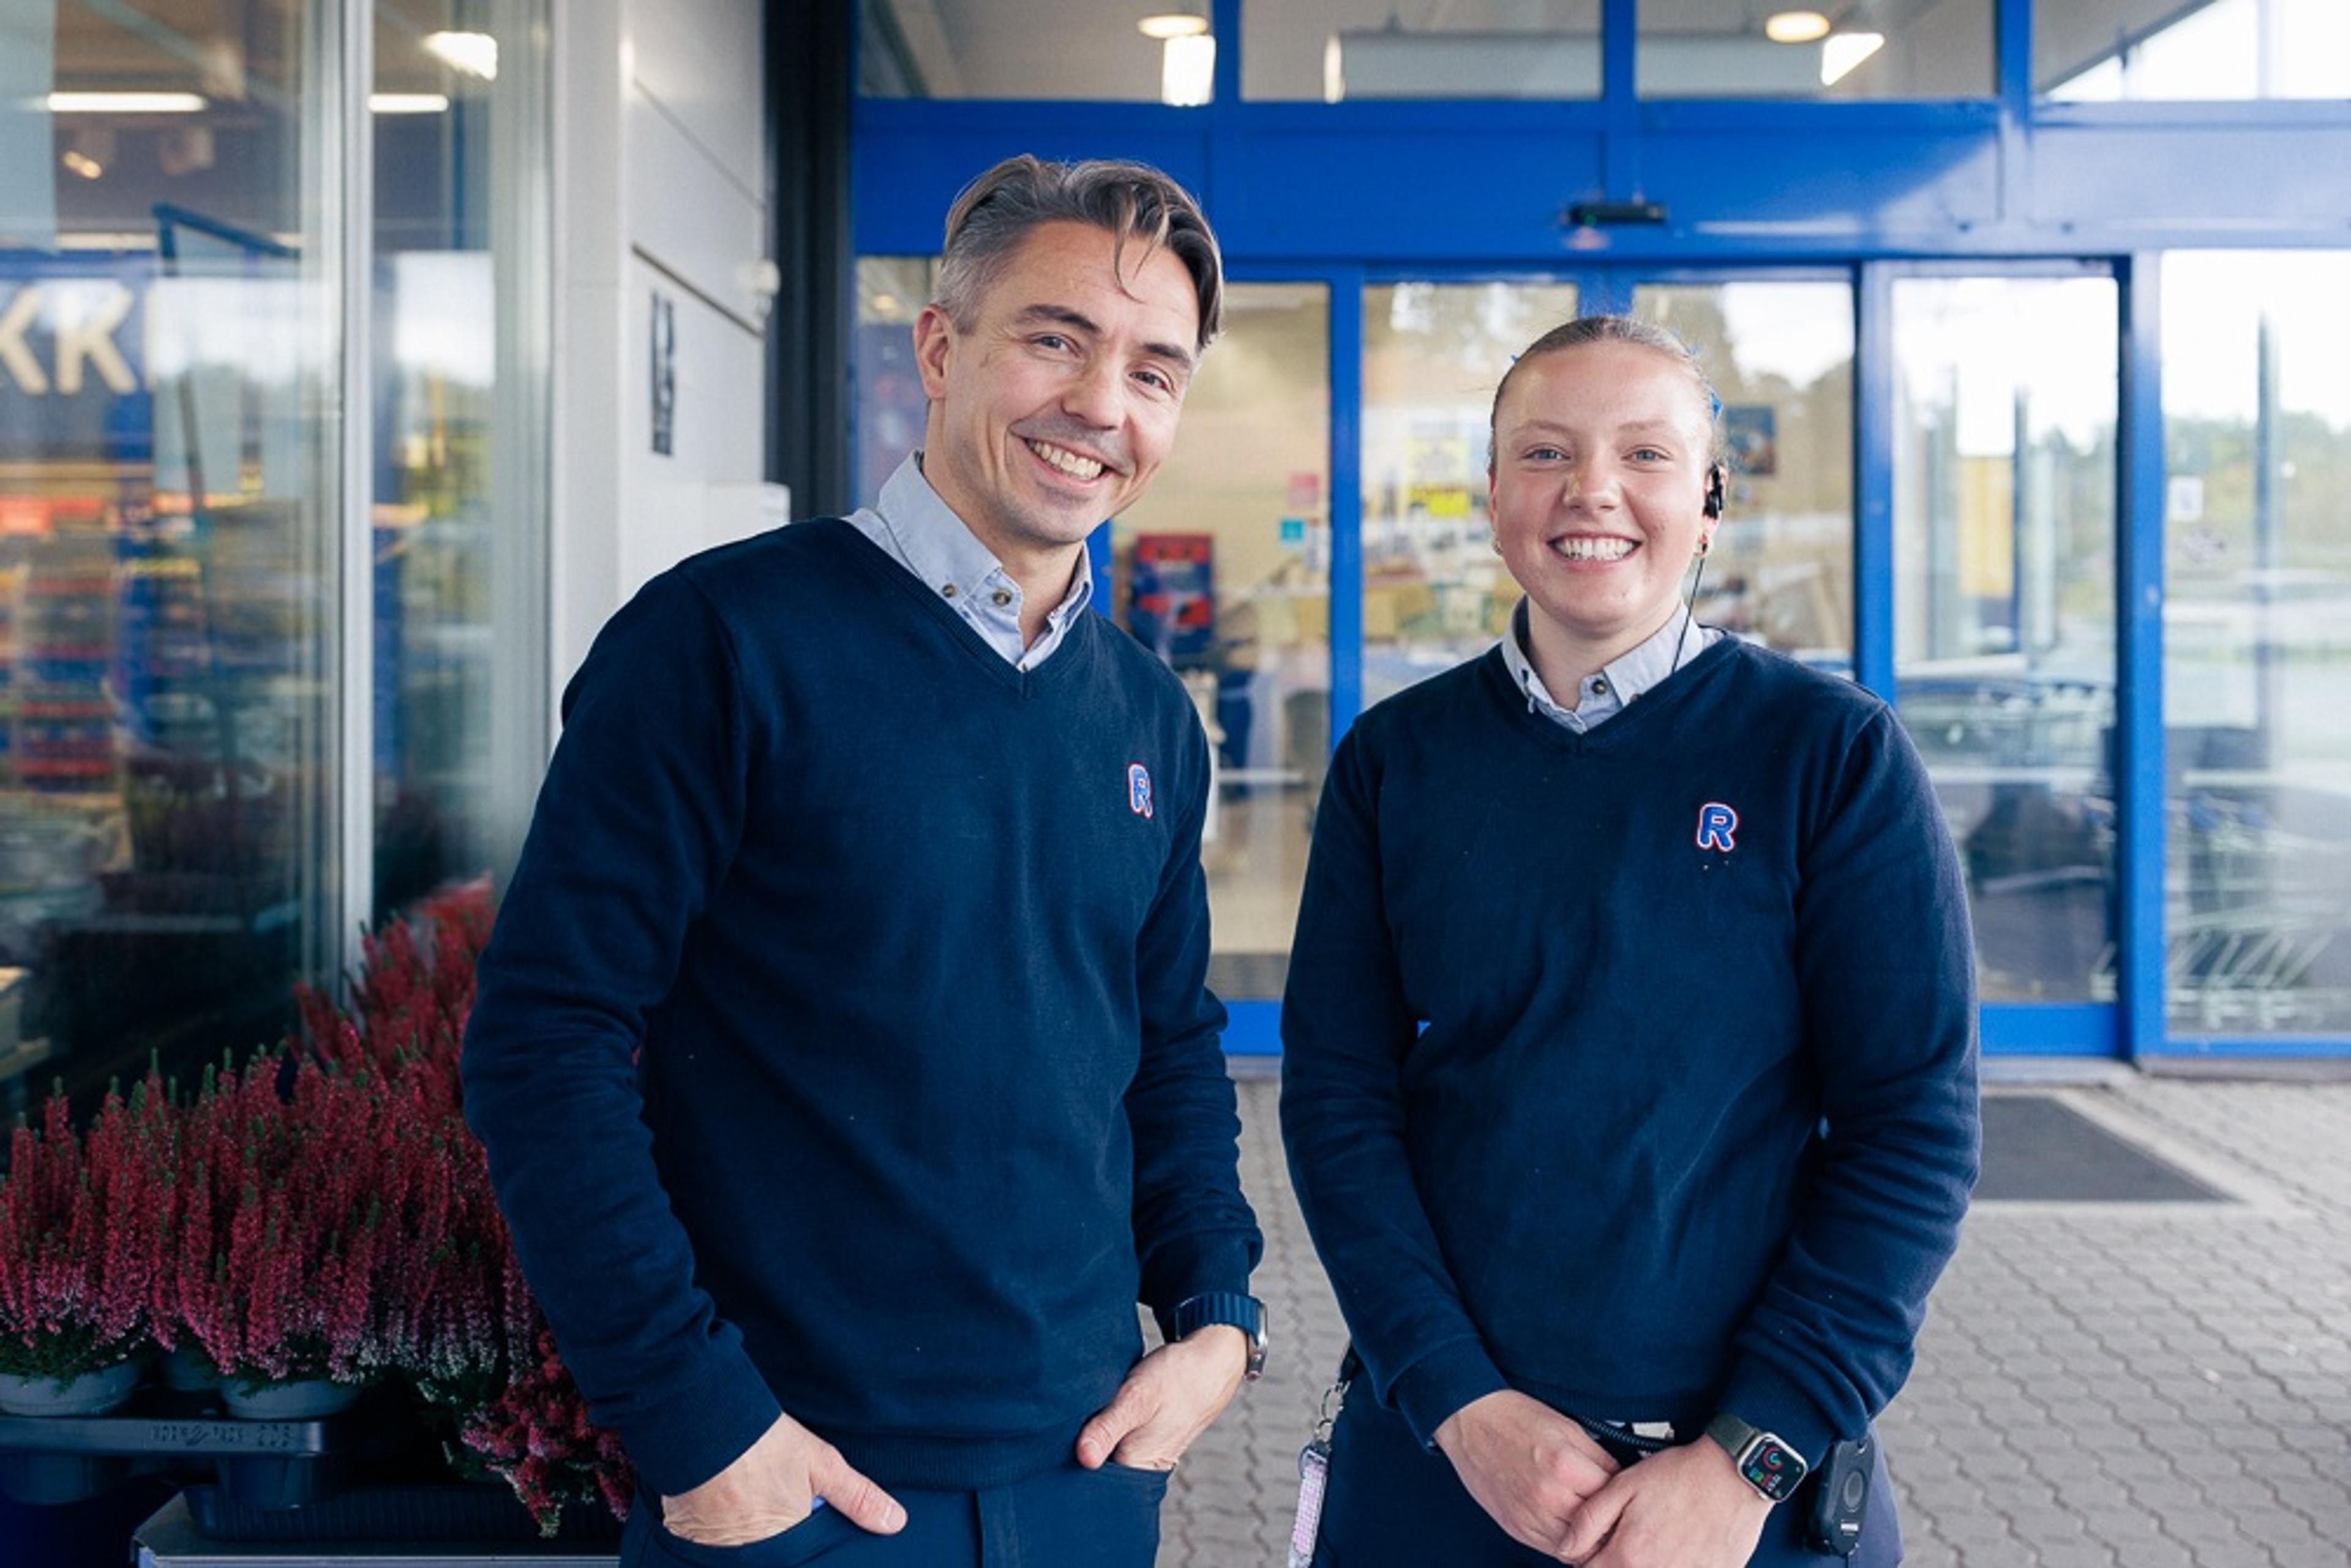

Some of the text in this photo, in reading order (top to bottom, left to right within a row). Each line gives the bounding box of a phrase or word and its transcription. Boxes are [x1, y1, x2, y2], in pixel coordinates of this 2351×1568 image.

[0, 285, 153, 394] KK
[1128, 763, 1153, 819] R
[1697, 801, 1739, 852] R
